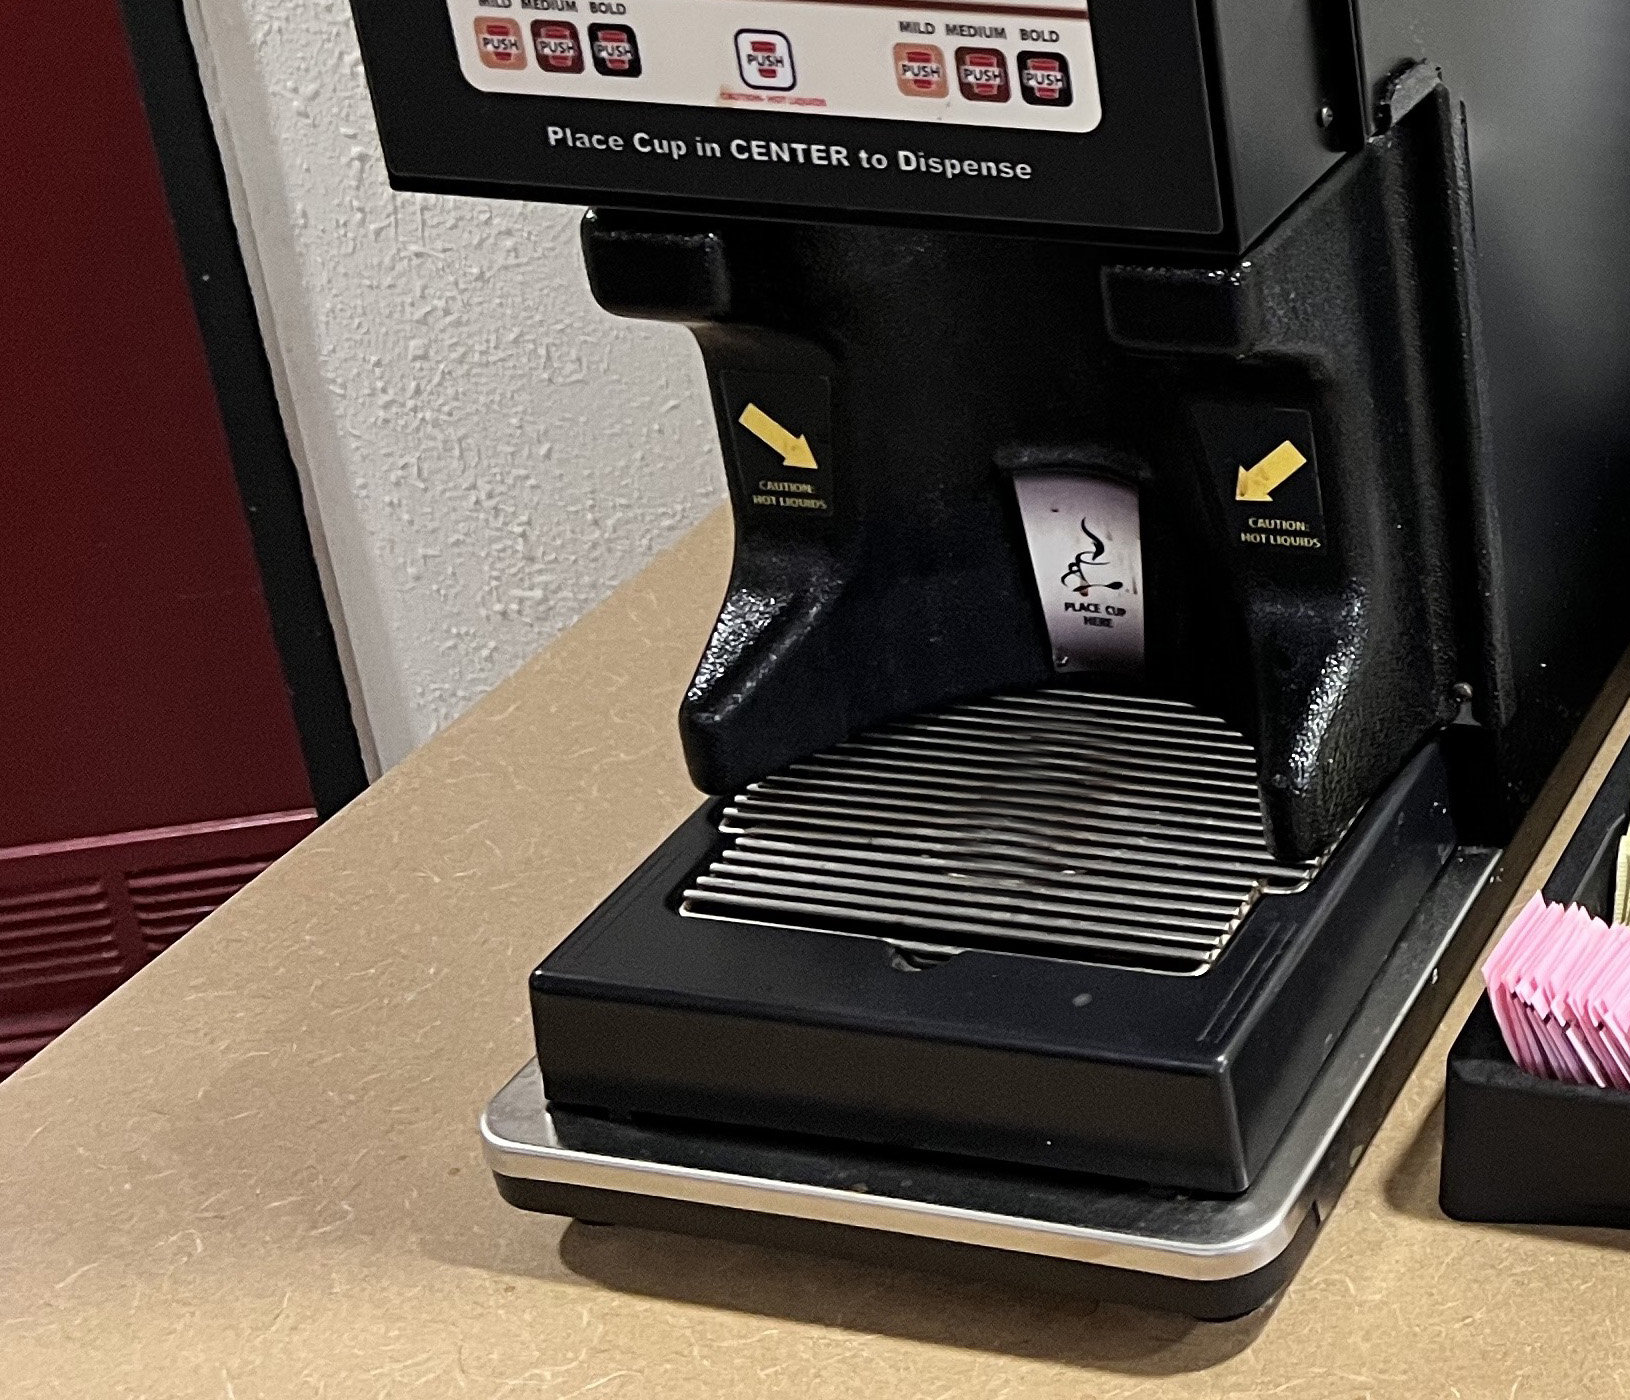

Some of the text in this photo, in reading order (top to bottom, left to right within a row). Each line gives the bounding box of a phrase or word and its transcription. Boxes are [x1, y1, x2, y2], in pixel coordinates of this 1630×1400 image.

[588, 1, 627, 16] BOLD
[900, 20, 1061, 43] MILD MEDIUM BOLD
[482, 36, 518, 50] PUSH
[538, 40, 575, 55] PUSH
[596, 43, 633, 58] PUSH
[746, 53, 785, 68] PUSH
[901, 63, 941, 79] PUSH
[962, 67, 1001, 83] PUSH
[1024, 71, 1065, 86] PUSH
[547, 125, 1032, 179] Place Cup in CENTER to Dispense
[752, 494, 828, 510] HOT LIQUIDS
[1248, 516, 1309, 532] CAUTION:
[1240, 532, 1321, 549] HOT LIQUIDS
[1064, 602, 1127, 617] PLACE CUP
[1083, 616, 1113, 628] HERE
